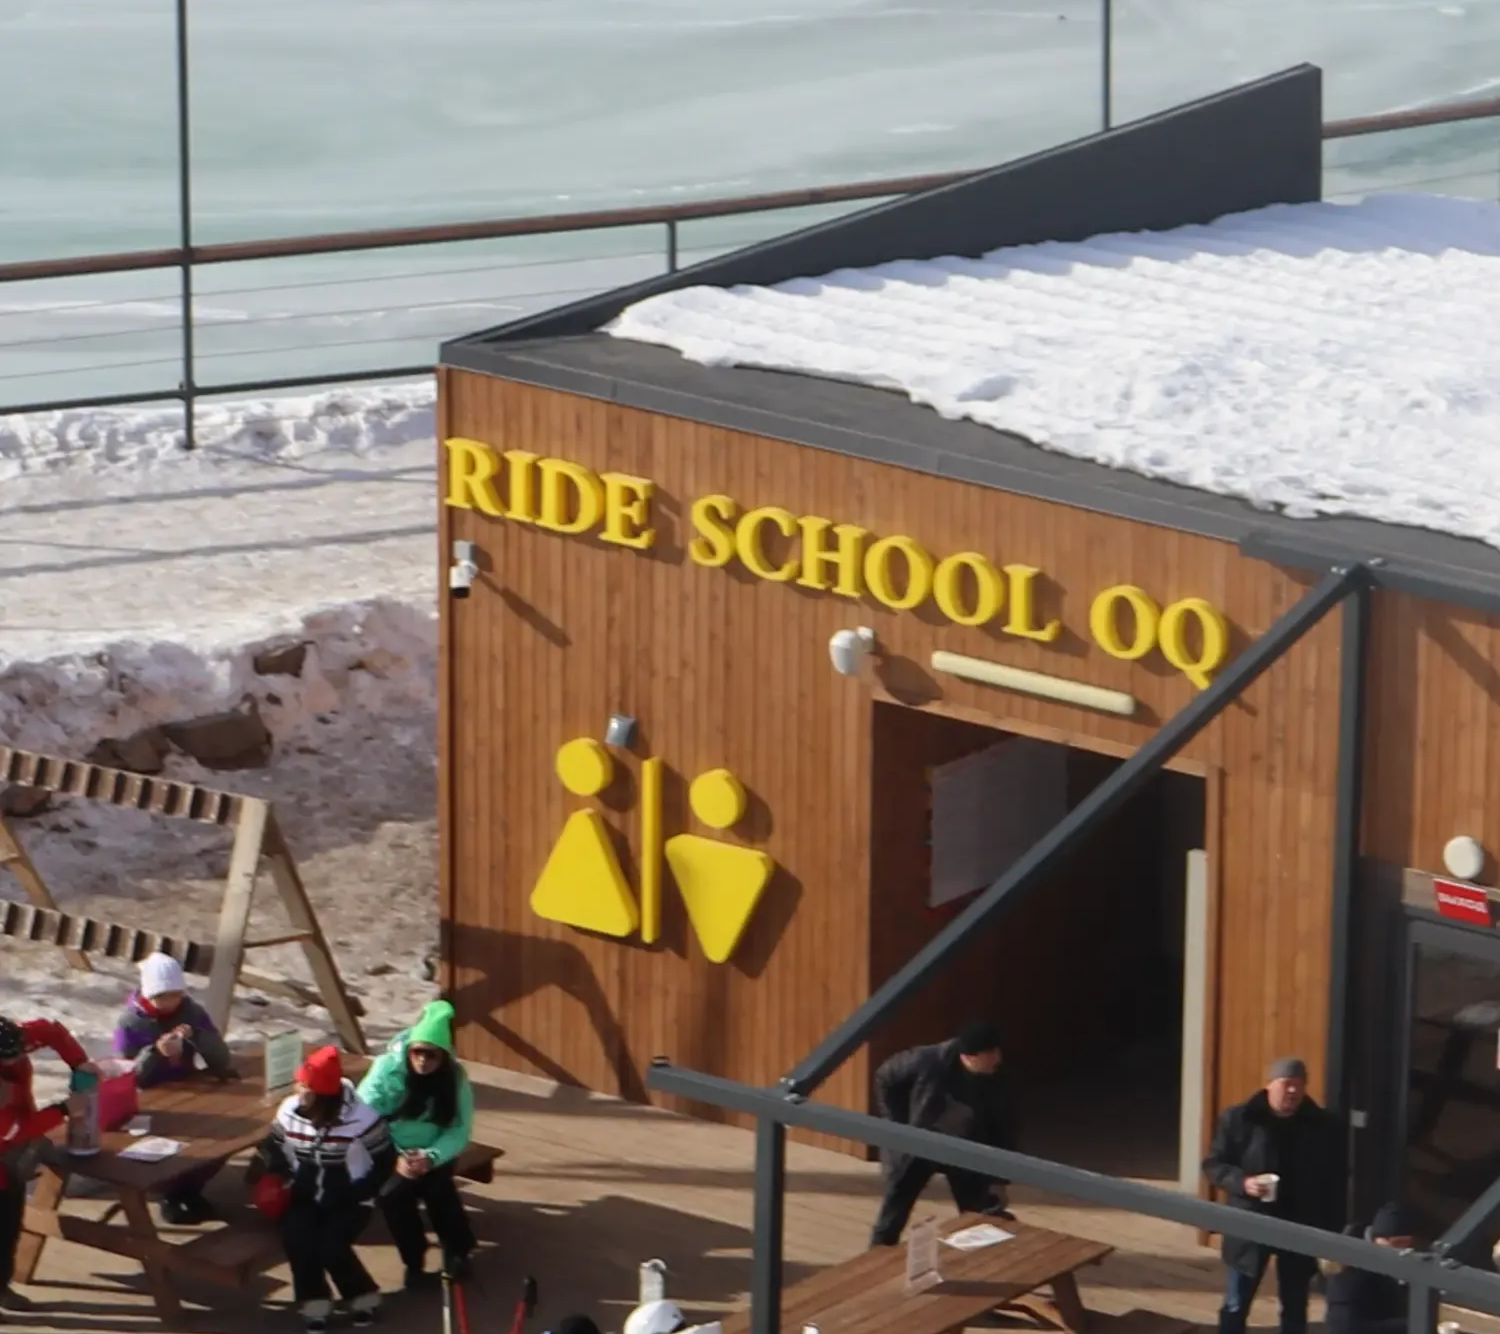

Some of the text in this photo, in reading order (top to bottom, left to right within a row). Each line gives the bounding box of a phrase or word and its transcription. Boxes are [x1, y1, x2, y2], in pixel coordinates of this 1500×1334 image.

[443, 436, 1229, 690] RIDE SCHOOL OQ
